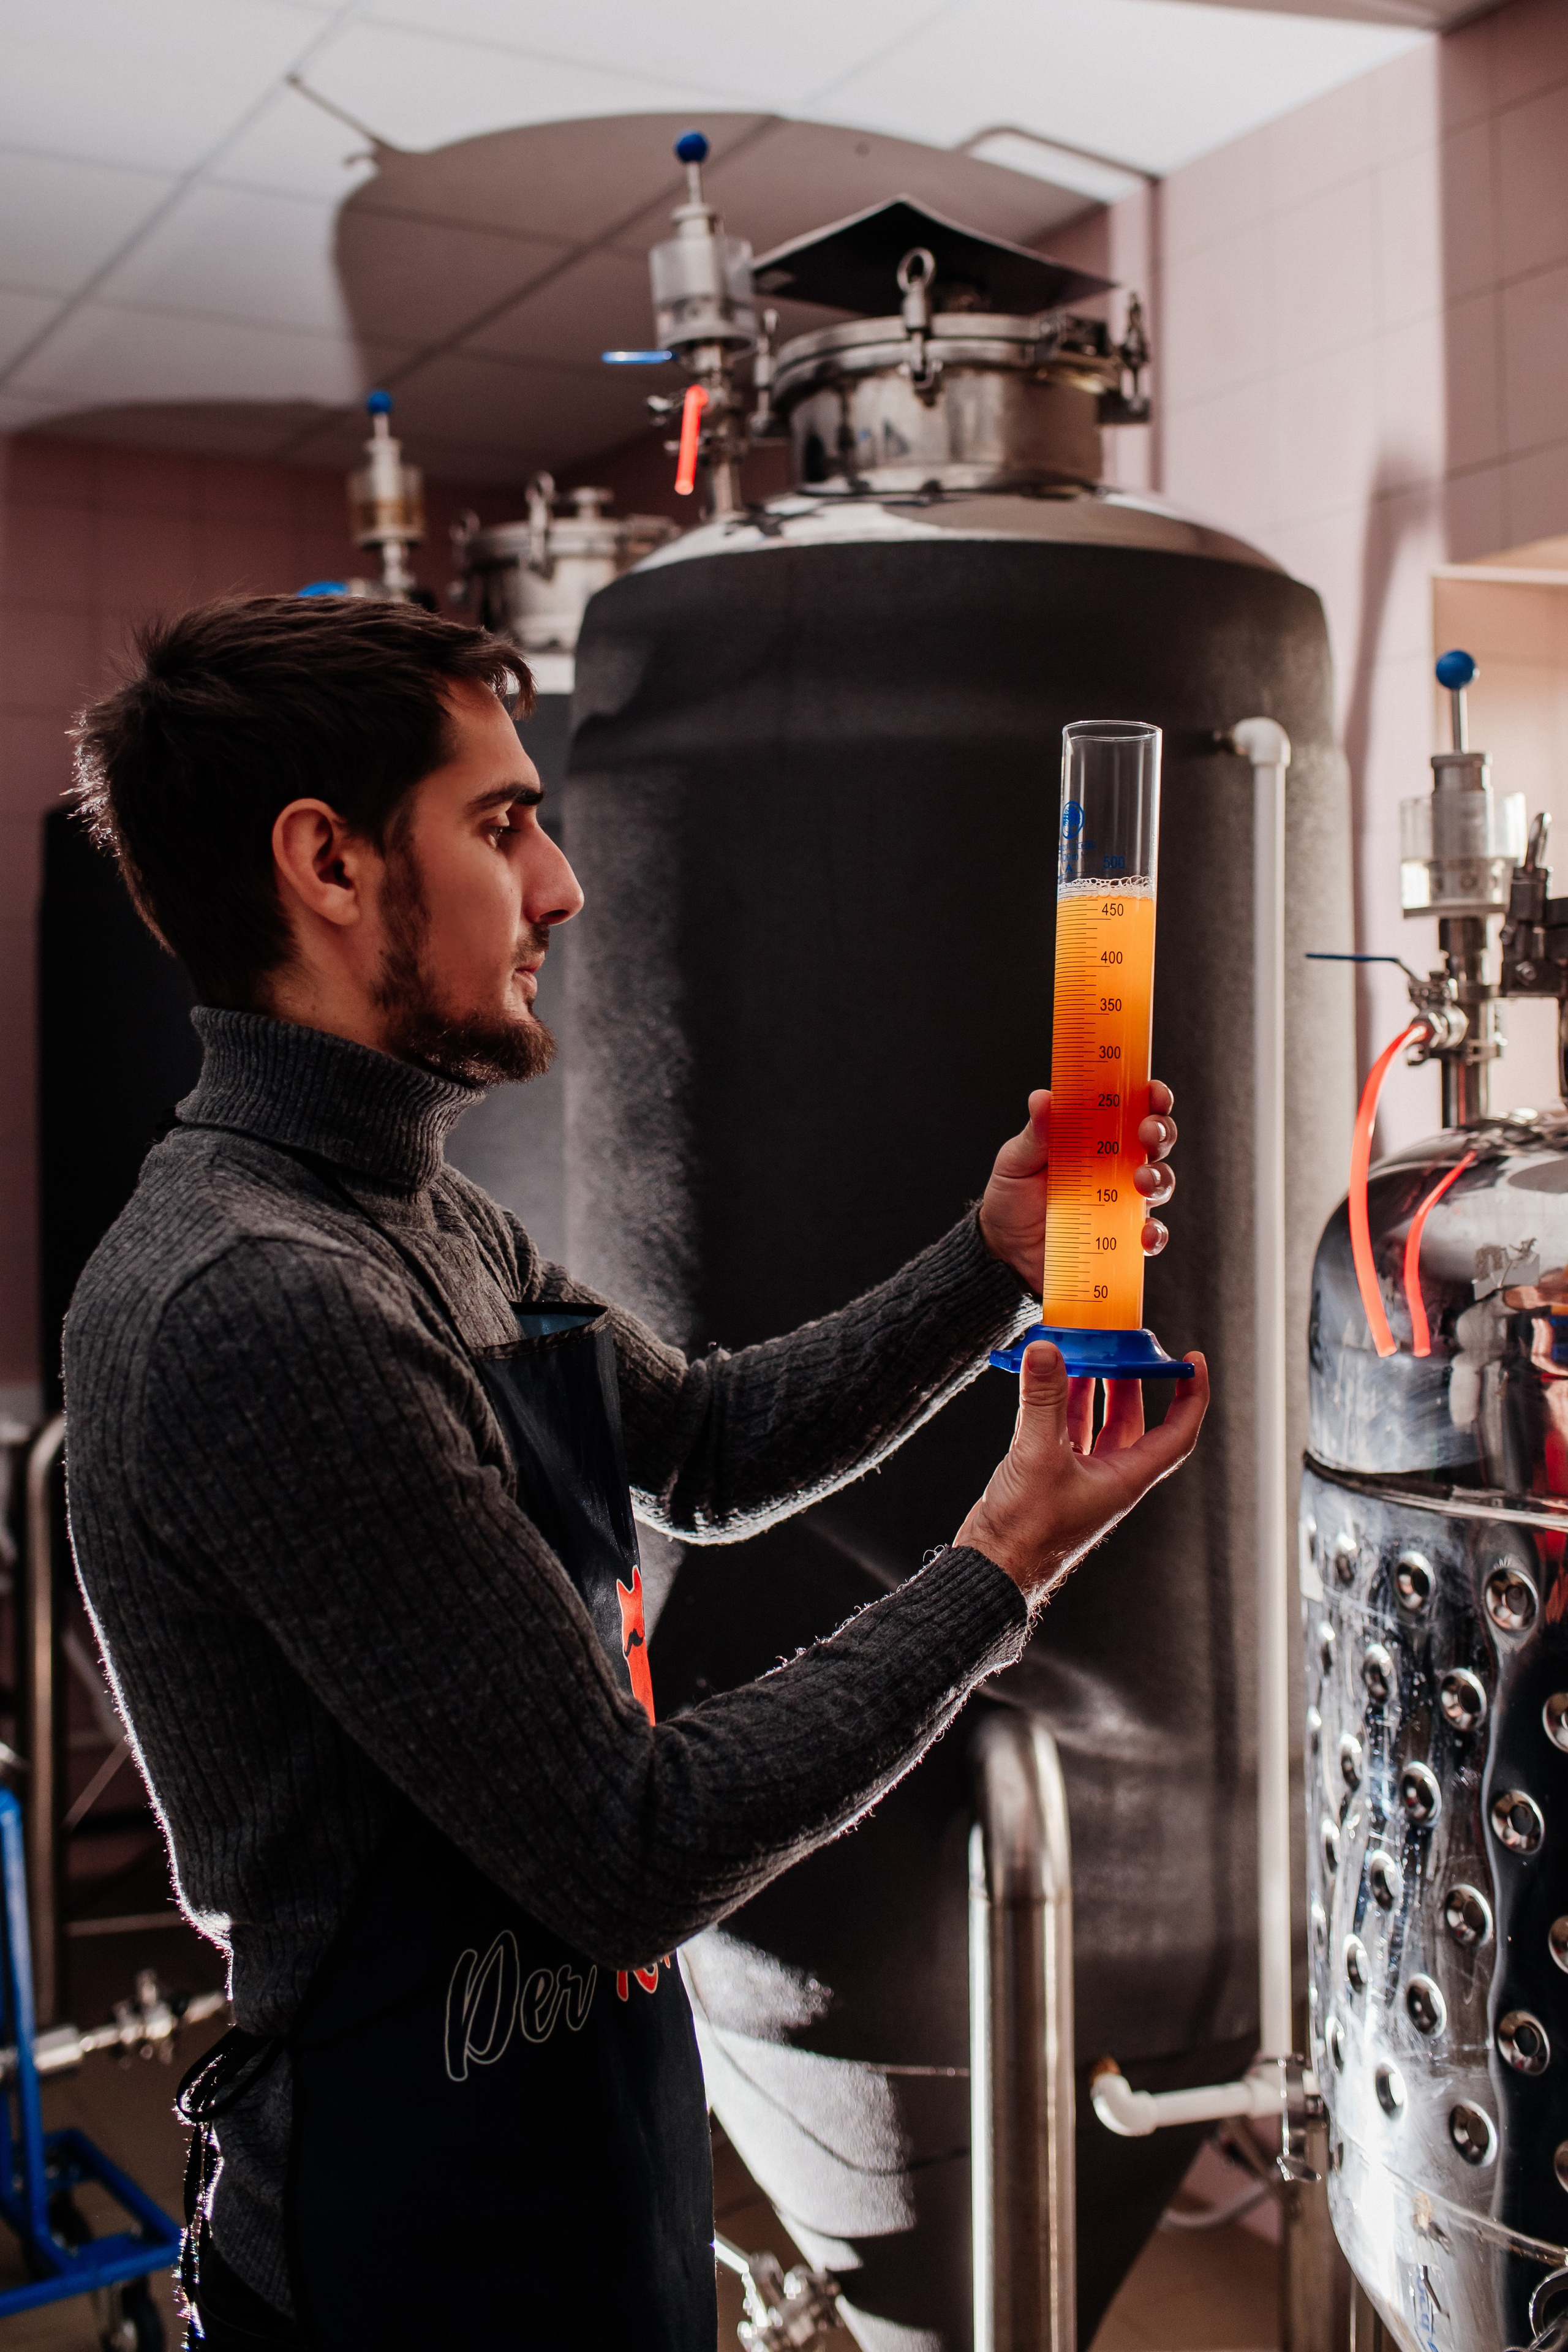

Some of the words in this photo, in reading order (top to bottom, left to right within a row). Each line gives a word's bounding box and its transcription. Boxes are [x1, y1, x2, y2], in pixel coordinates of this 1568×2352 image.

[1102, 855, 1125, 869] 500
[1101, 903, 1124, 916] 450
[1101, 951, 1123, 964] 400
[1100, 998, 1122, 1012] 350
[1099, 1045, 1121, 1060] 300
[1098, 1093, 1120, 1107] 250
[1096, 1140, 1119, 1155] 200
[1096, 1189, 1118, 1202] 150
[1095, 1237, 1117, 1251] 100
[1093, 1285, 1108, 1298] 50
